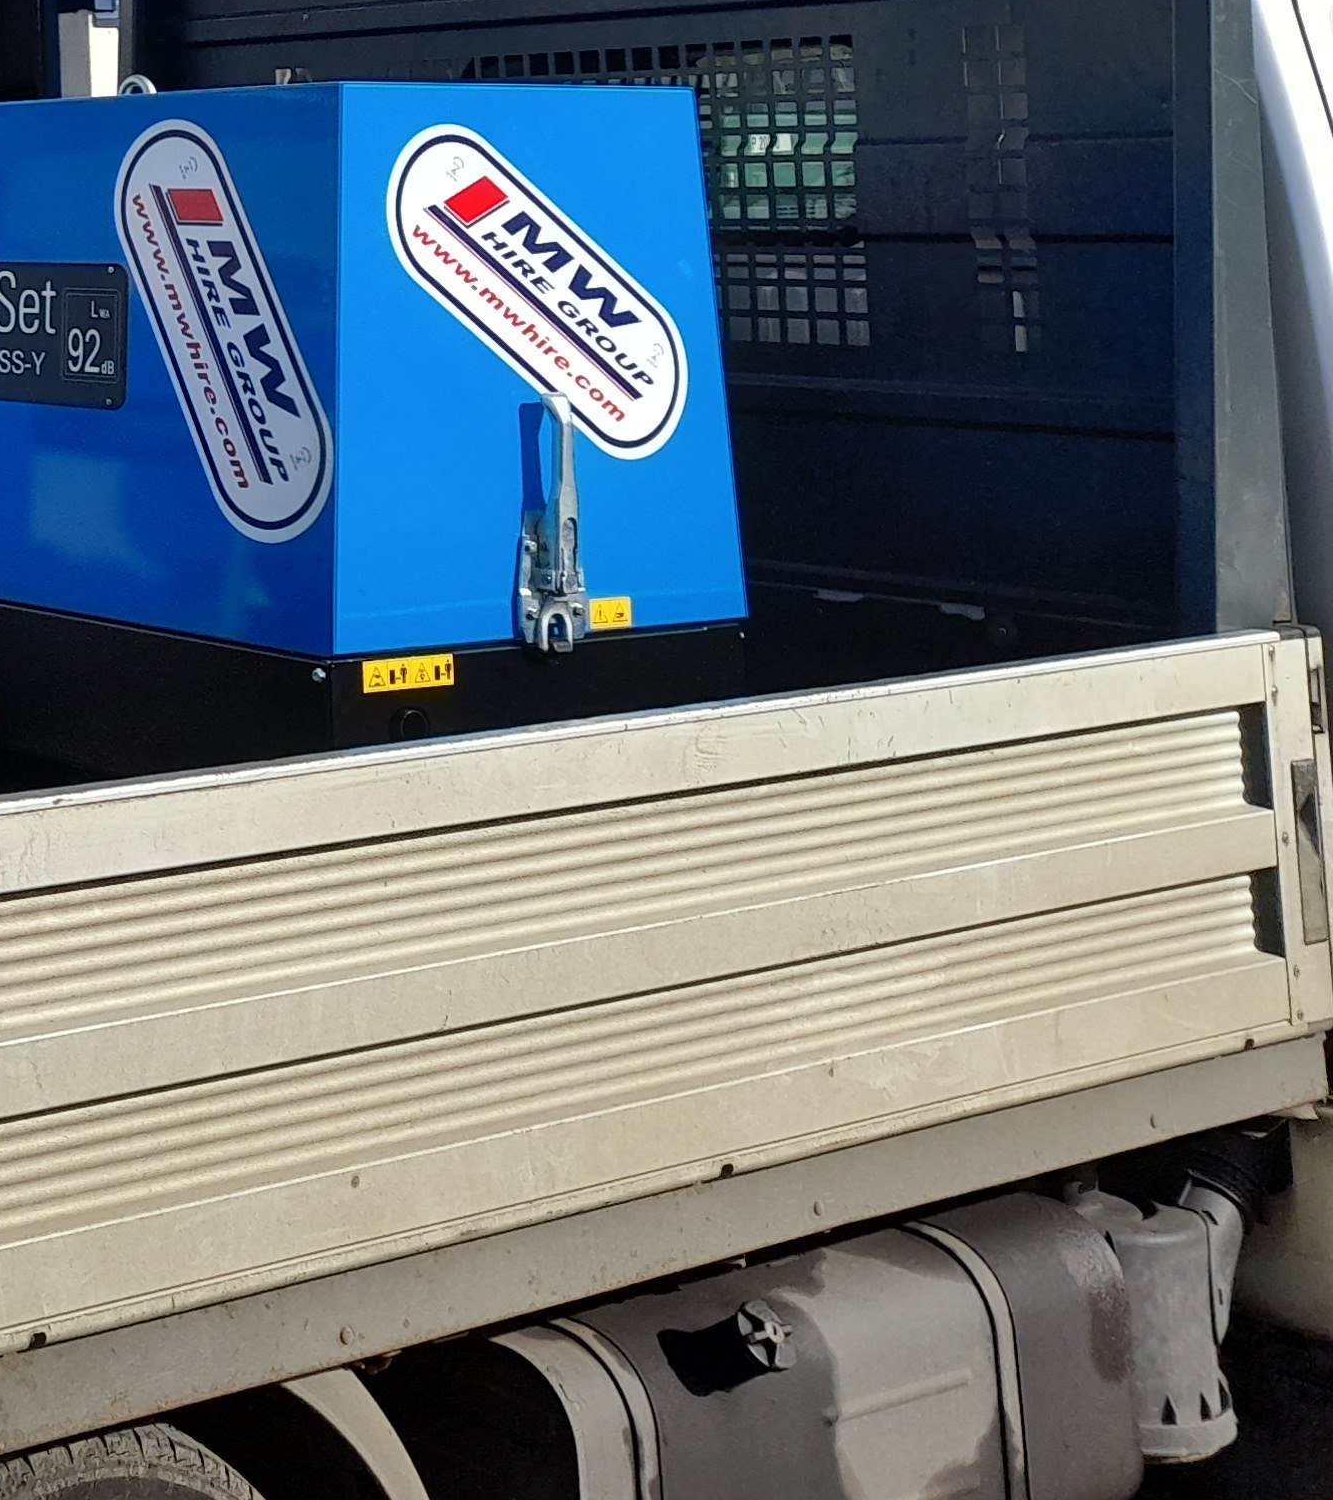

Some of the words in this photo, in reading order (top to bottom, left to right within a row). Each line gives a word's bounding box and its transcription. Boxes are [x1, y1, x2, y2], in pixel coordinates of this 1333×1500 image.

[68, 328, 101, 373] 92
[132, 193, 250, 490] www.mwhire.com
[206, 239, 302, 419] MW
[411, 224, 627, 423] www.mwhire.com
[481, 231, 556, 295] HIRE
[557, 300, 655, 386] GROUP
[501, 210, 643, 329] MW
[185, 238, 231, 330] HIRE
[226, 341, 292, 483] GROUP
